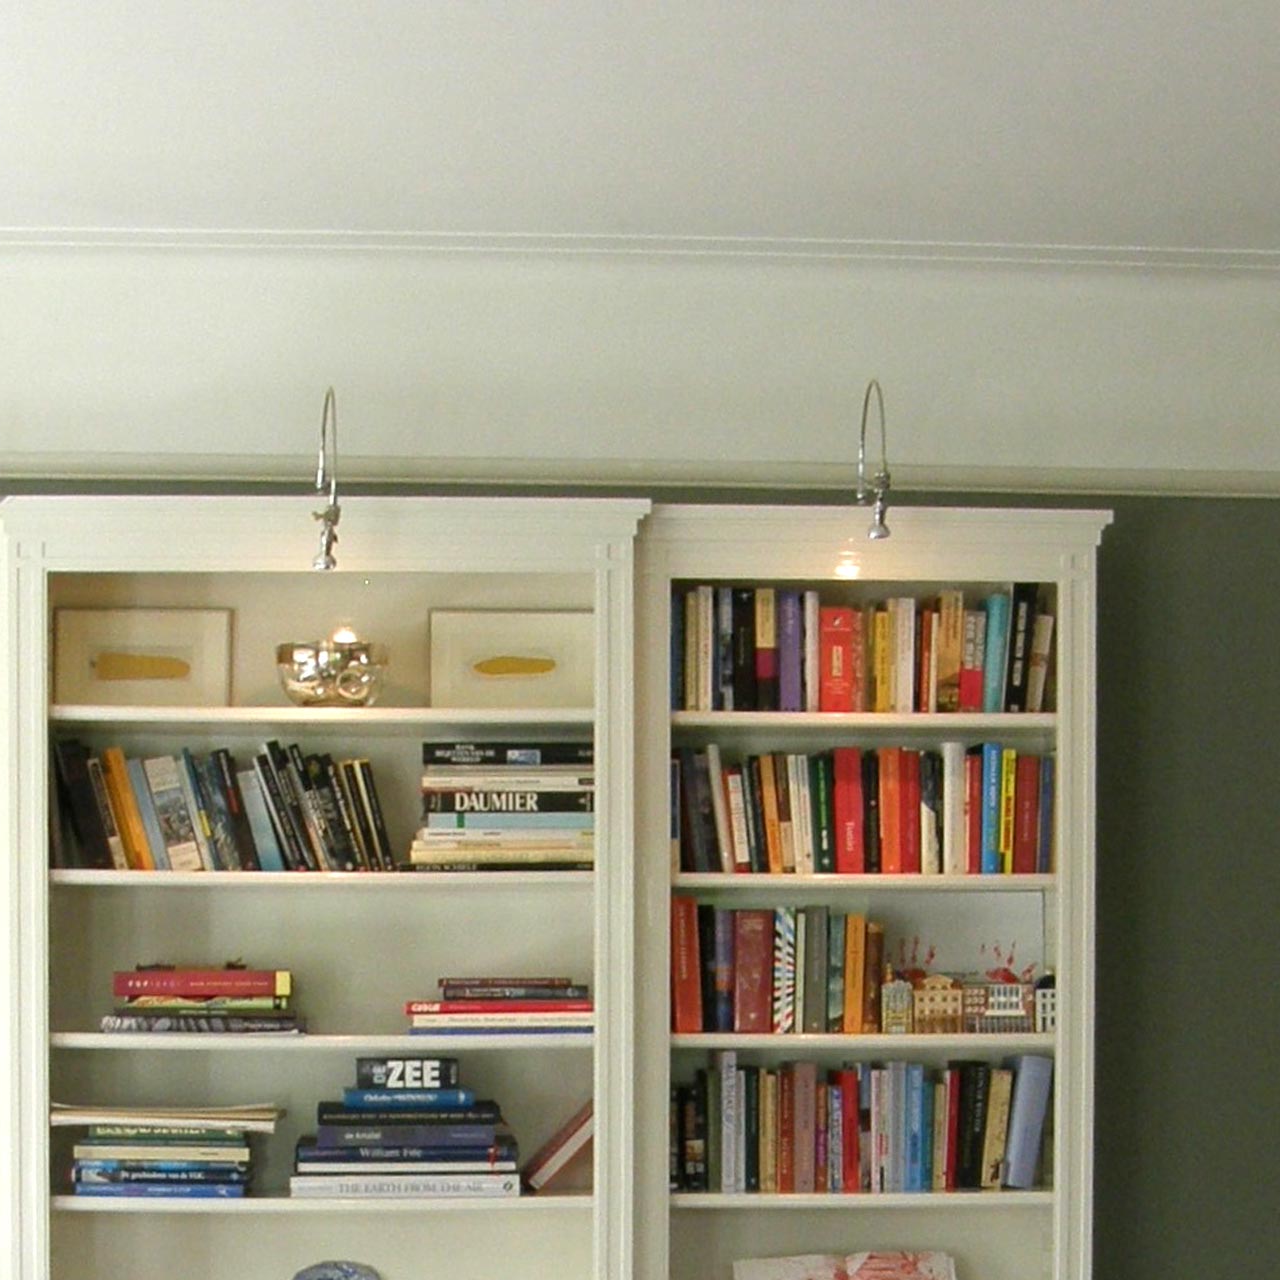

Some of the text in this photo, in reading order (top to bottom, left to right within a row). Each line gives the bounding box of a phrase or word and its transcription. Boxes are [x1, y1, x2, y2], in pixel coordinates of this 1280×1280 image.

[454, 792, 539, 812] DAUMIER
[386, 1060, 441, 1088] ZEE
[338, 1183, 360, 1193] THE
[364, 1183, 400, 1193] EARTH
[403, 1183, 436, 1193] FROM
[440, 1183, 461, 1193] THE
